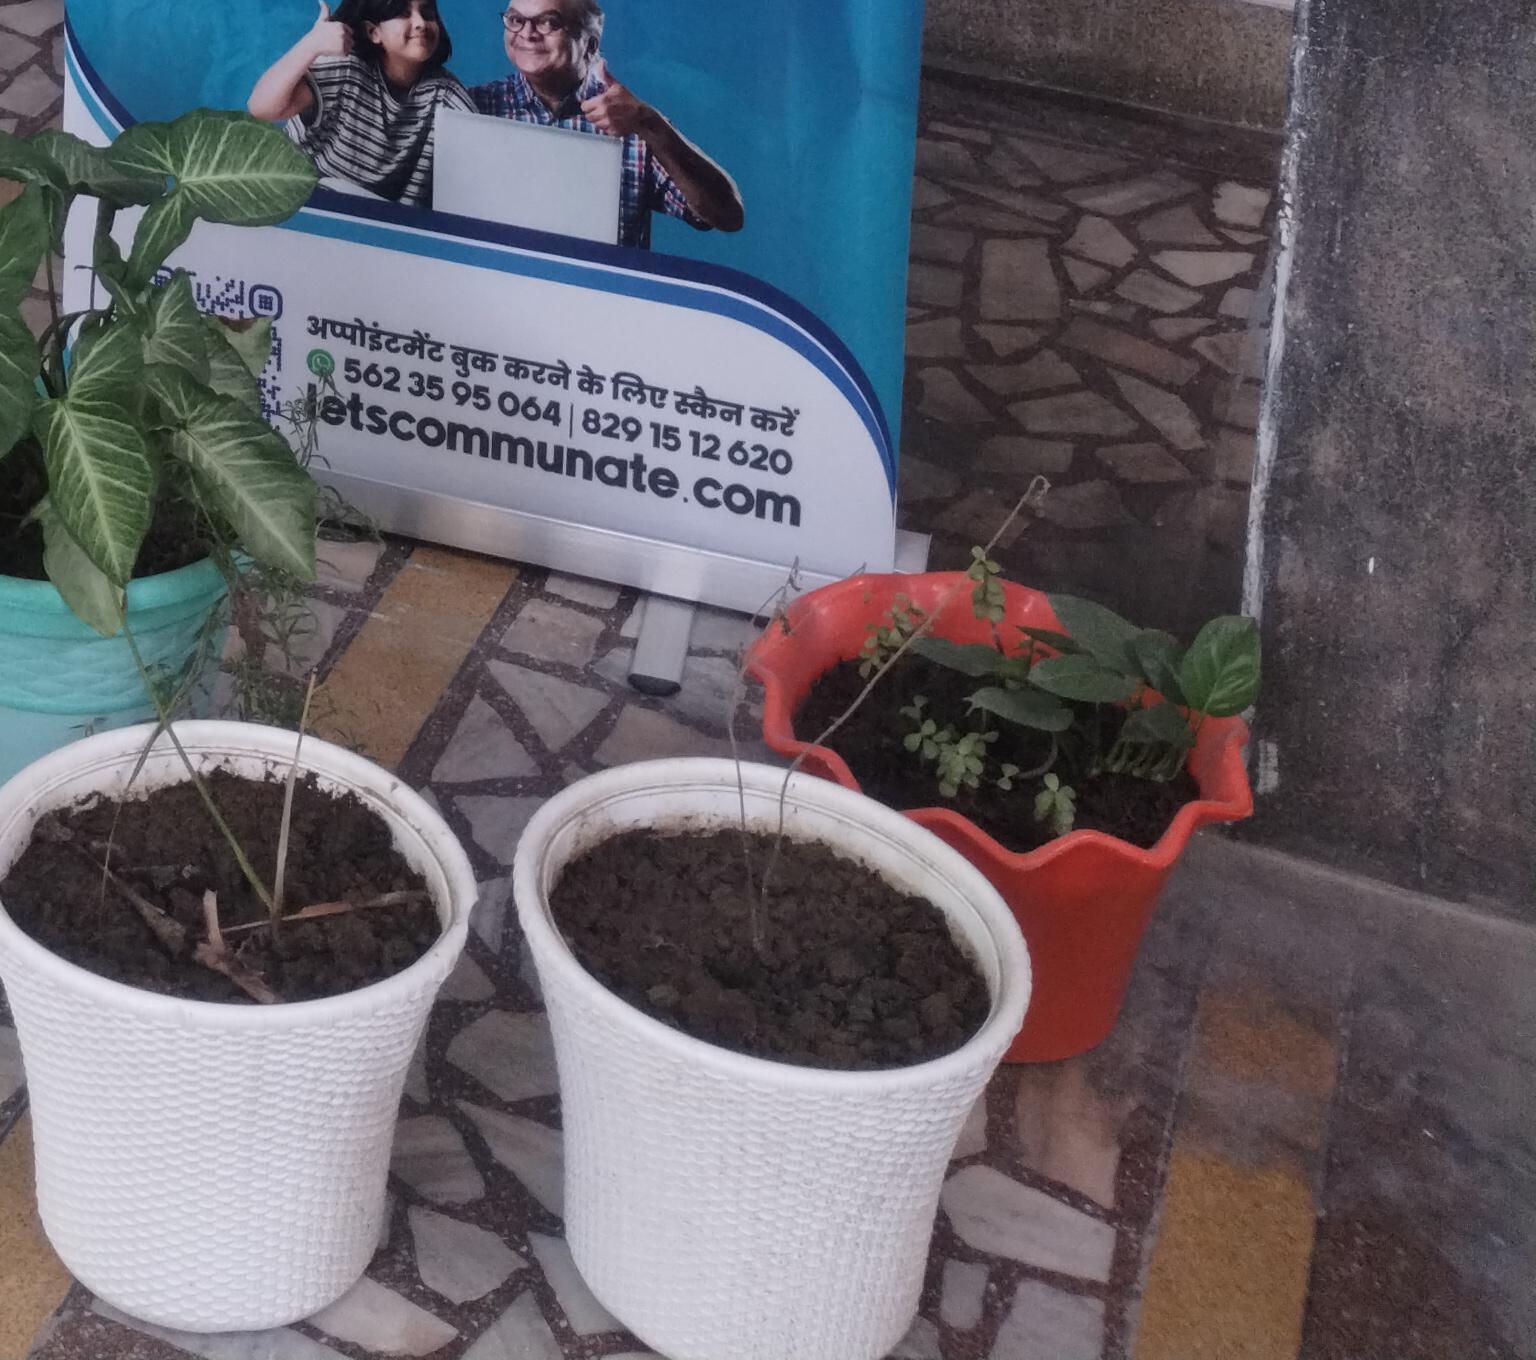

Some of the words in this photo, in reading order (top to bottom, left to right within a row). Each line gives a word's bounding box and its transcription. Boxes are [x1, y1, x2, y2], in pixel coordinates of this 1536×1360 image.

[344, 357, 401, 392] 562
[408, 372, 445, 401] 35
[451, 380, 492, 411] 95
[497, 390, 562, 427] 064
[581, 407, 643, 444] 829
[649, 421, 682, 453] 15
[688, 430, 721, 461] 12
[727, 440, 793, 476] 620
[450, 343, 499, 378] बुक
[503, 354, 572, 391] करने
[576, 364, 606, 396] के
[610, 371, 669, 410] लिए
[673, 385, 745, 427] स्कैन
[749, 405, 801, 438] करें
